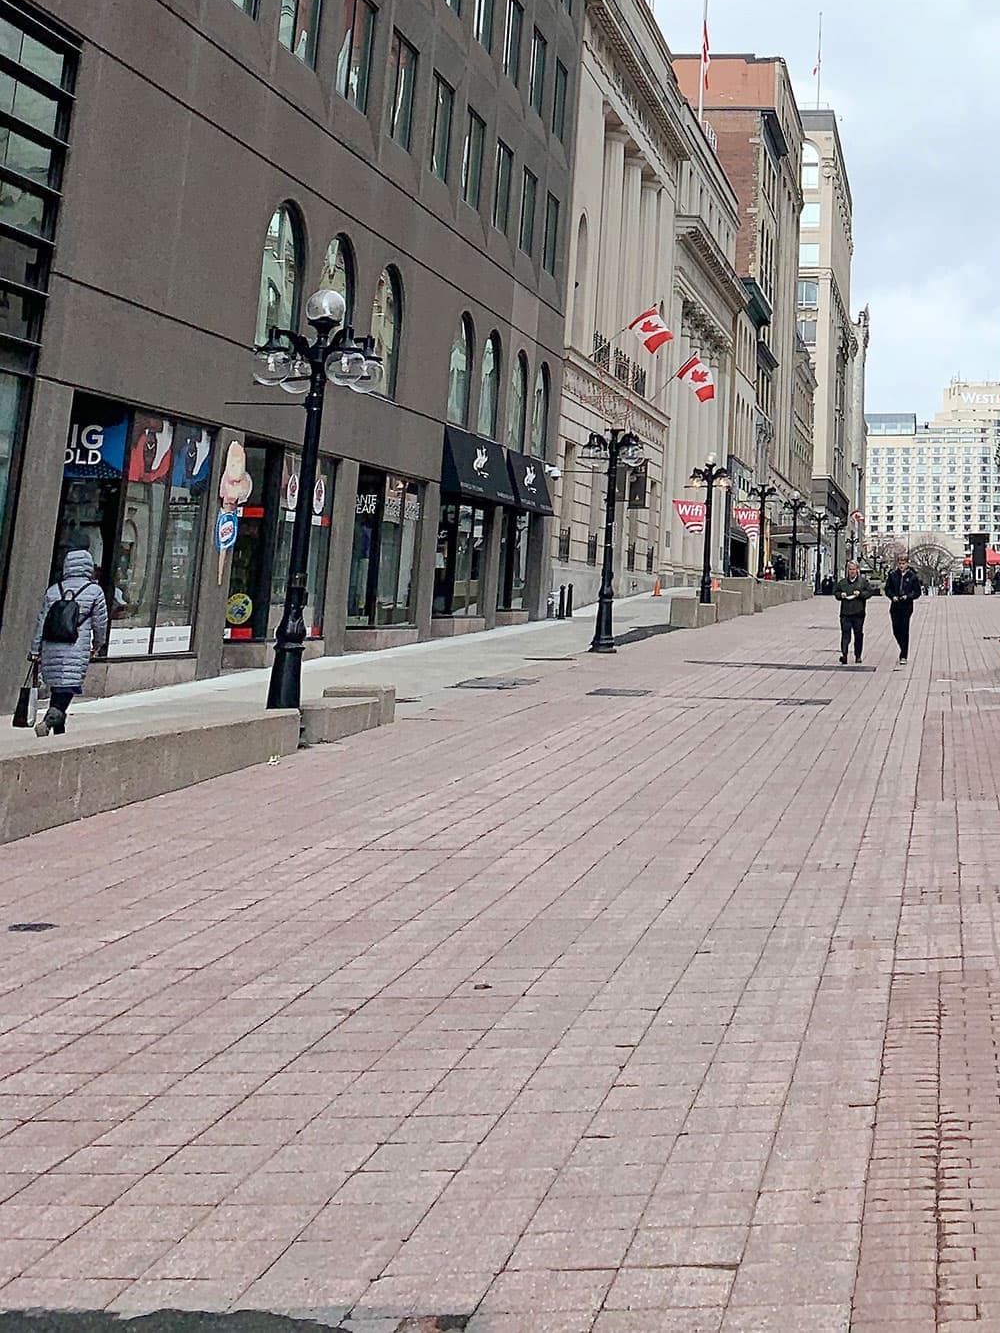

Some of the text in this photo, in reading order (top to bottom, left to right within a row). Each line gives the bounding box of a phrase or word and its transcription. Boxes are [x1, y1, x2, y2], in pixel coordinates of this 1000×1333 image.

[70, 423, 104, 450] IG
[64, 448, 102, 465] OLD
[356, 504, 376, 514] EAR
[678, 503, 703, 516] Wifi
[738, 509, 758, 521] Wifi
